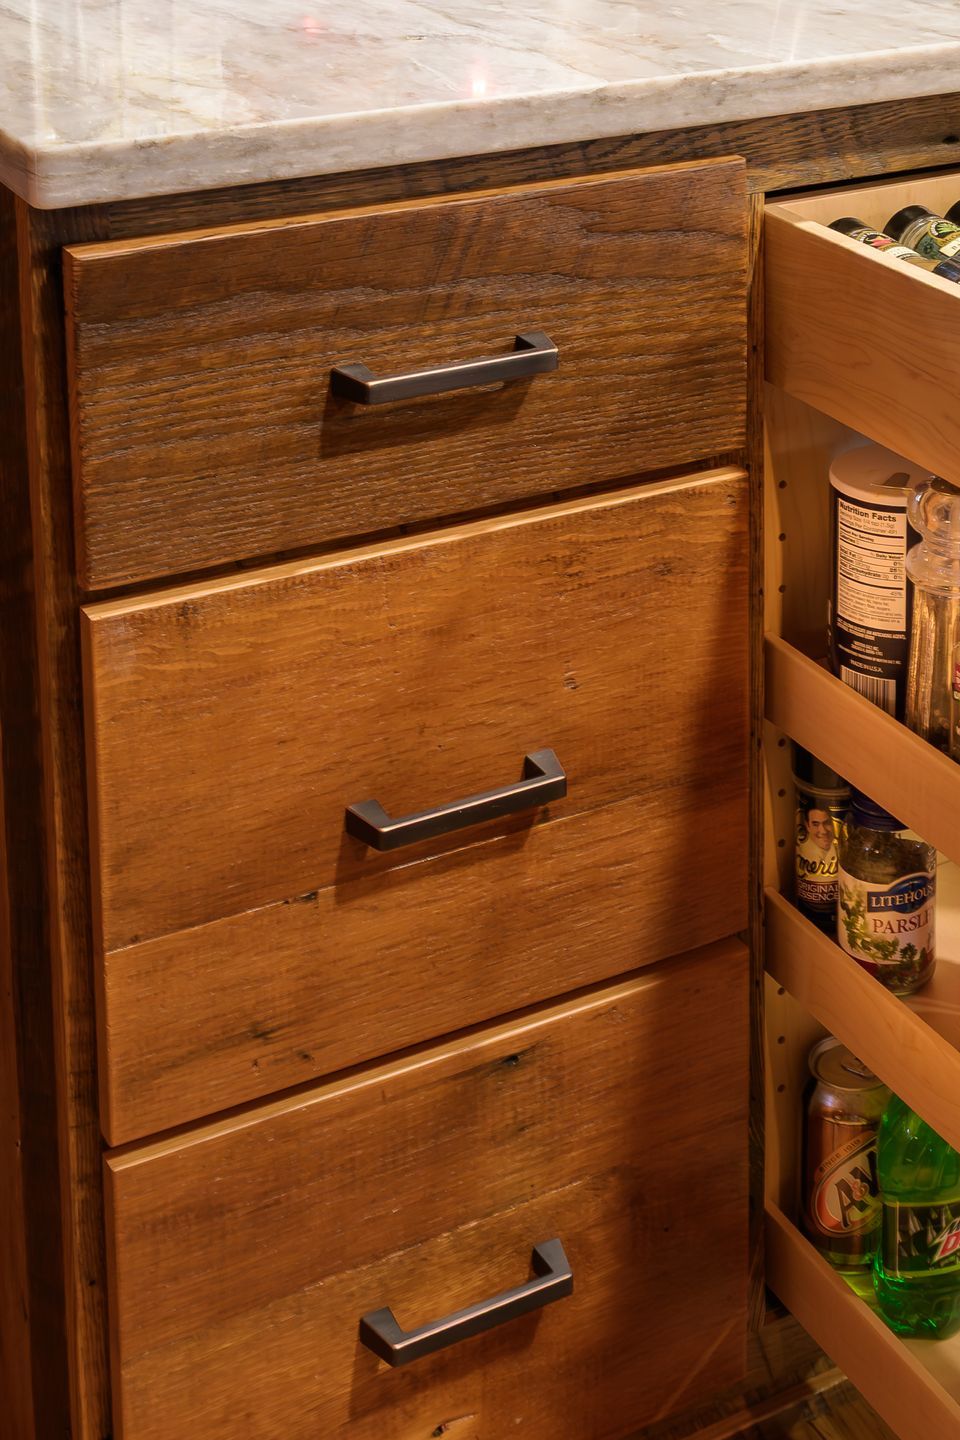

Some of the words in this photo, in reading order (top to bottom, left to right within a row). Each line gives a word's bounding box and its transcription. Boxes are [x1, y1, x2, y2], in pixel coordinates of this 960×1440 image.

[840, 501, 869, 518] Nutrition
[872, 513, 897, 522] Facts
[871, 884, 935, 908] LITEHOUS
